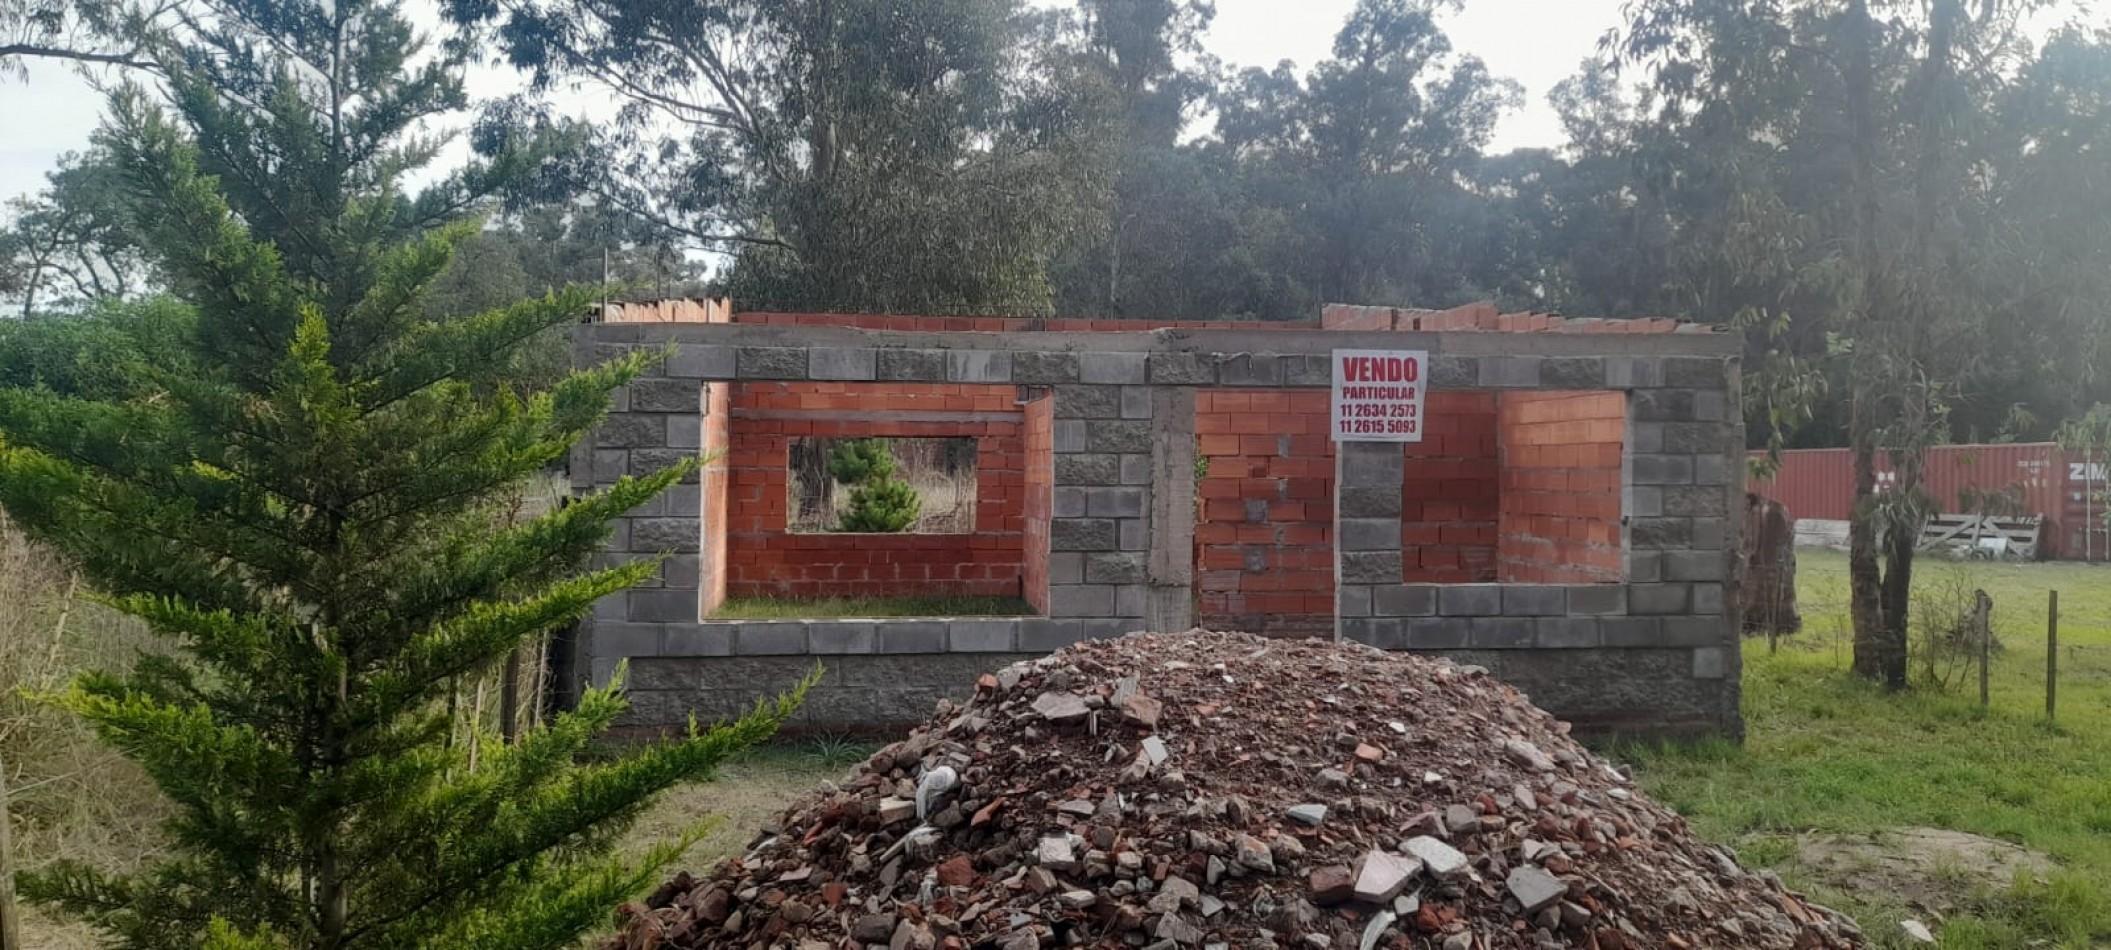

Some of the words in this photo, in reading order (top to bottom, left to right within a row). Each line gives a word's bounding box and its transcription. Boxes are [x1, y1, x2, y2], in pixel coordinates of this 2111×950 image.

[1342, 357, 1418, 382] VENDO
[1342, 386, 1415, 400] PARTICULAR
[1340, 404, 1352, 417] 11
[1355, 404, 1387, 417] 2634
[1390, 404, 1416, 417] 2573
[1339, 420, 1352, 433] 11
[1355, 420, 1385, 433] 2615
[1388, 420, 1416, 433] 5093
